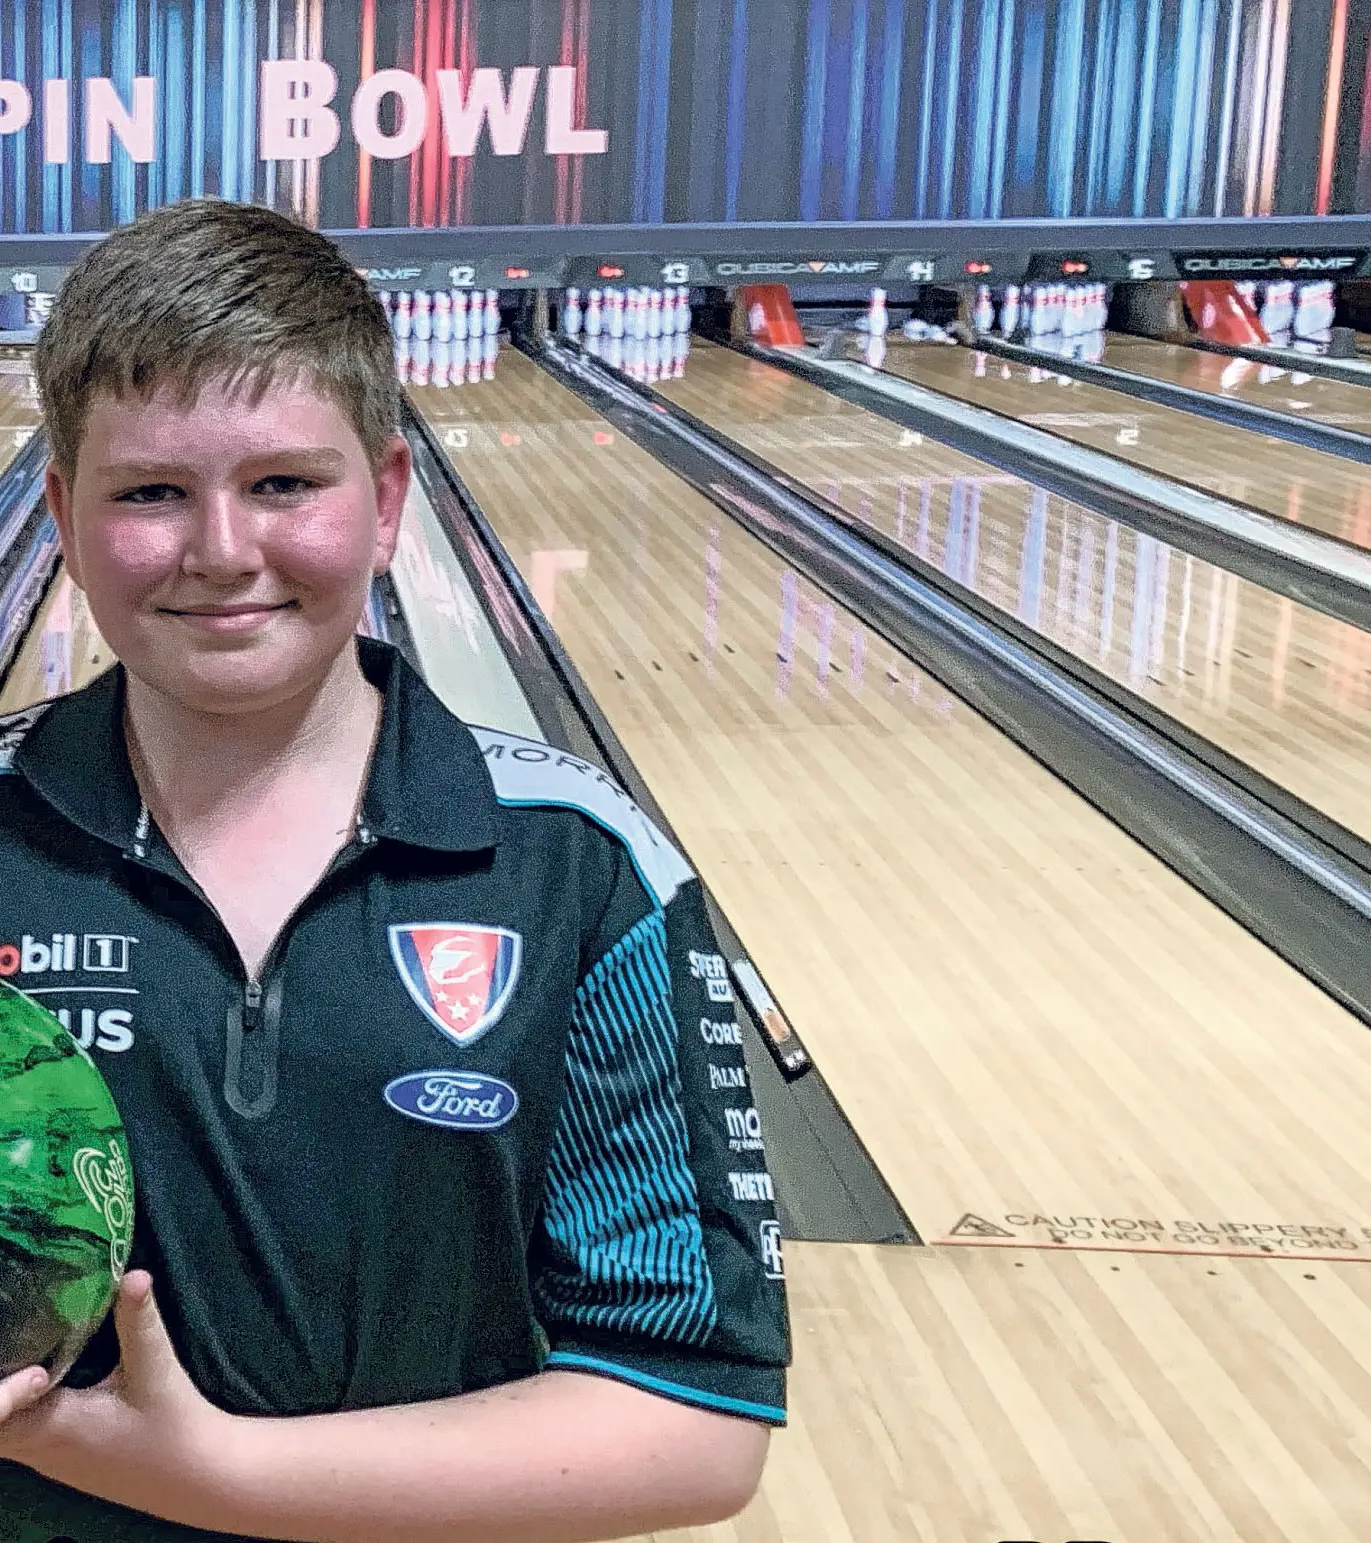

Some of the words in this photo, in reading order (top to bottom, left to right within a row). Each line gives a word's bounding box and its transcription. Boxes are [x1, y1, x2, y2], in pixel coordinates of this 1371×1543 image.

[259, 59, 609, 161] BOWL
[448, 265, 476, 287] 12
[661, 262, 690, 284] 13
[415, 1075, 502, 1120] Ford
[1004, 1213, 1166, 1231] CAUTION
[1173, 1219, 1348, 1238] SLIPPERY
[1047, 1227, 1093, 1241] DO
[1100, 1230, 1161, 1243] NOT
[1172, 1232, 1220, 1246] GO
[1226, 1235, 1359, 1250] BEYOND
